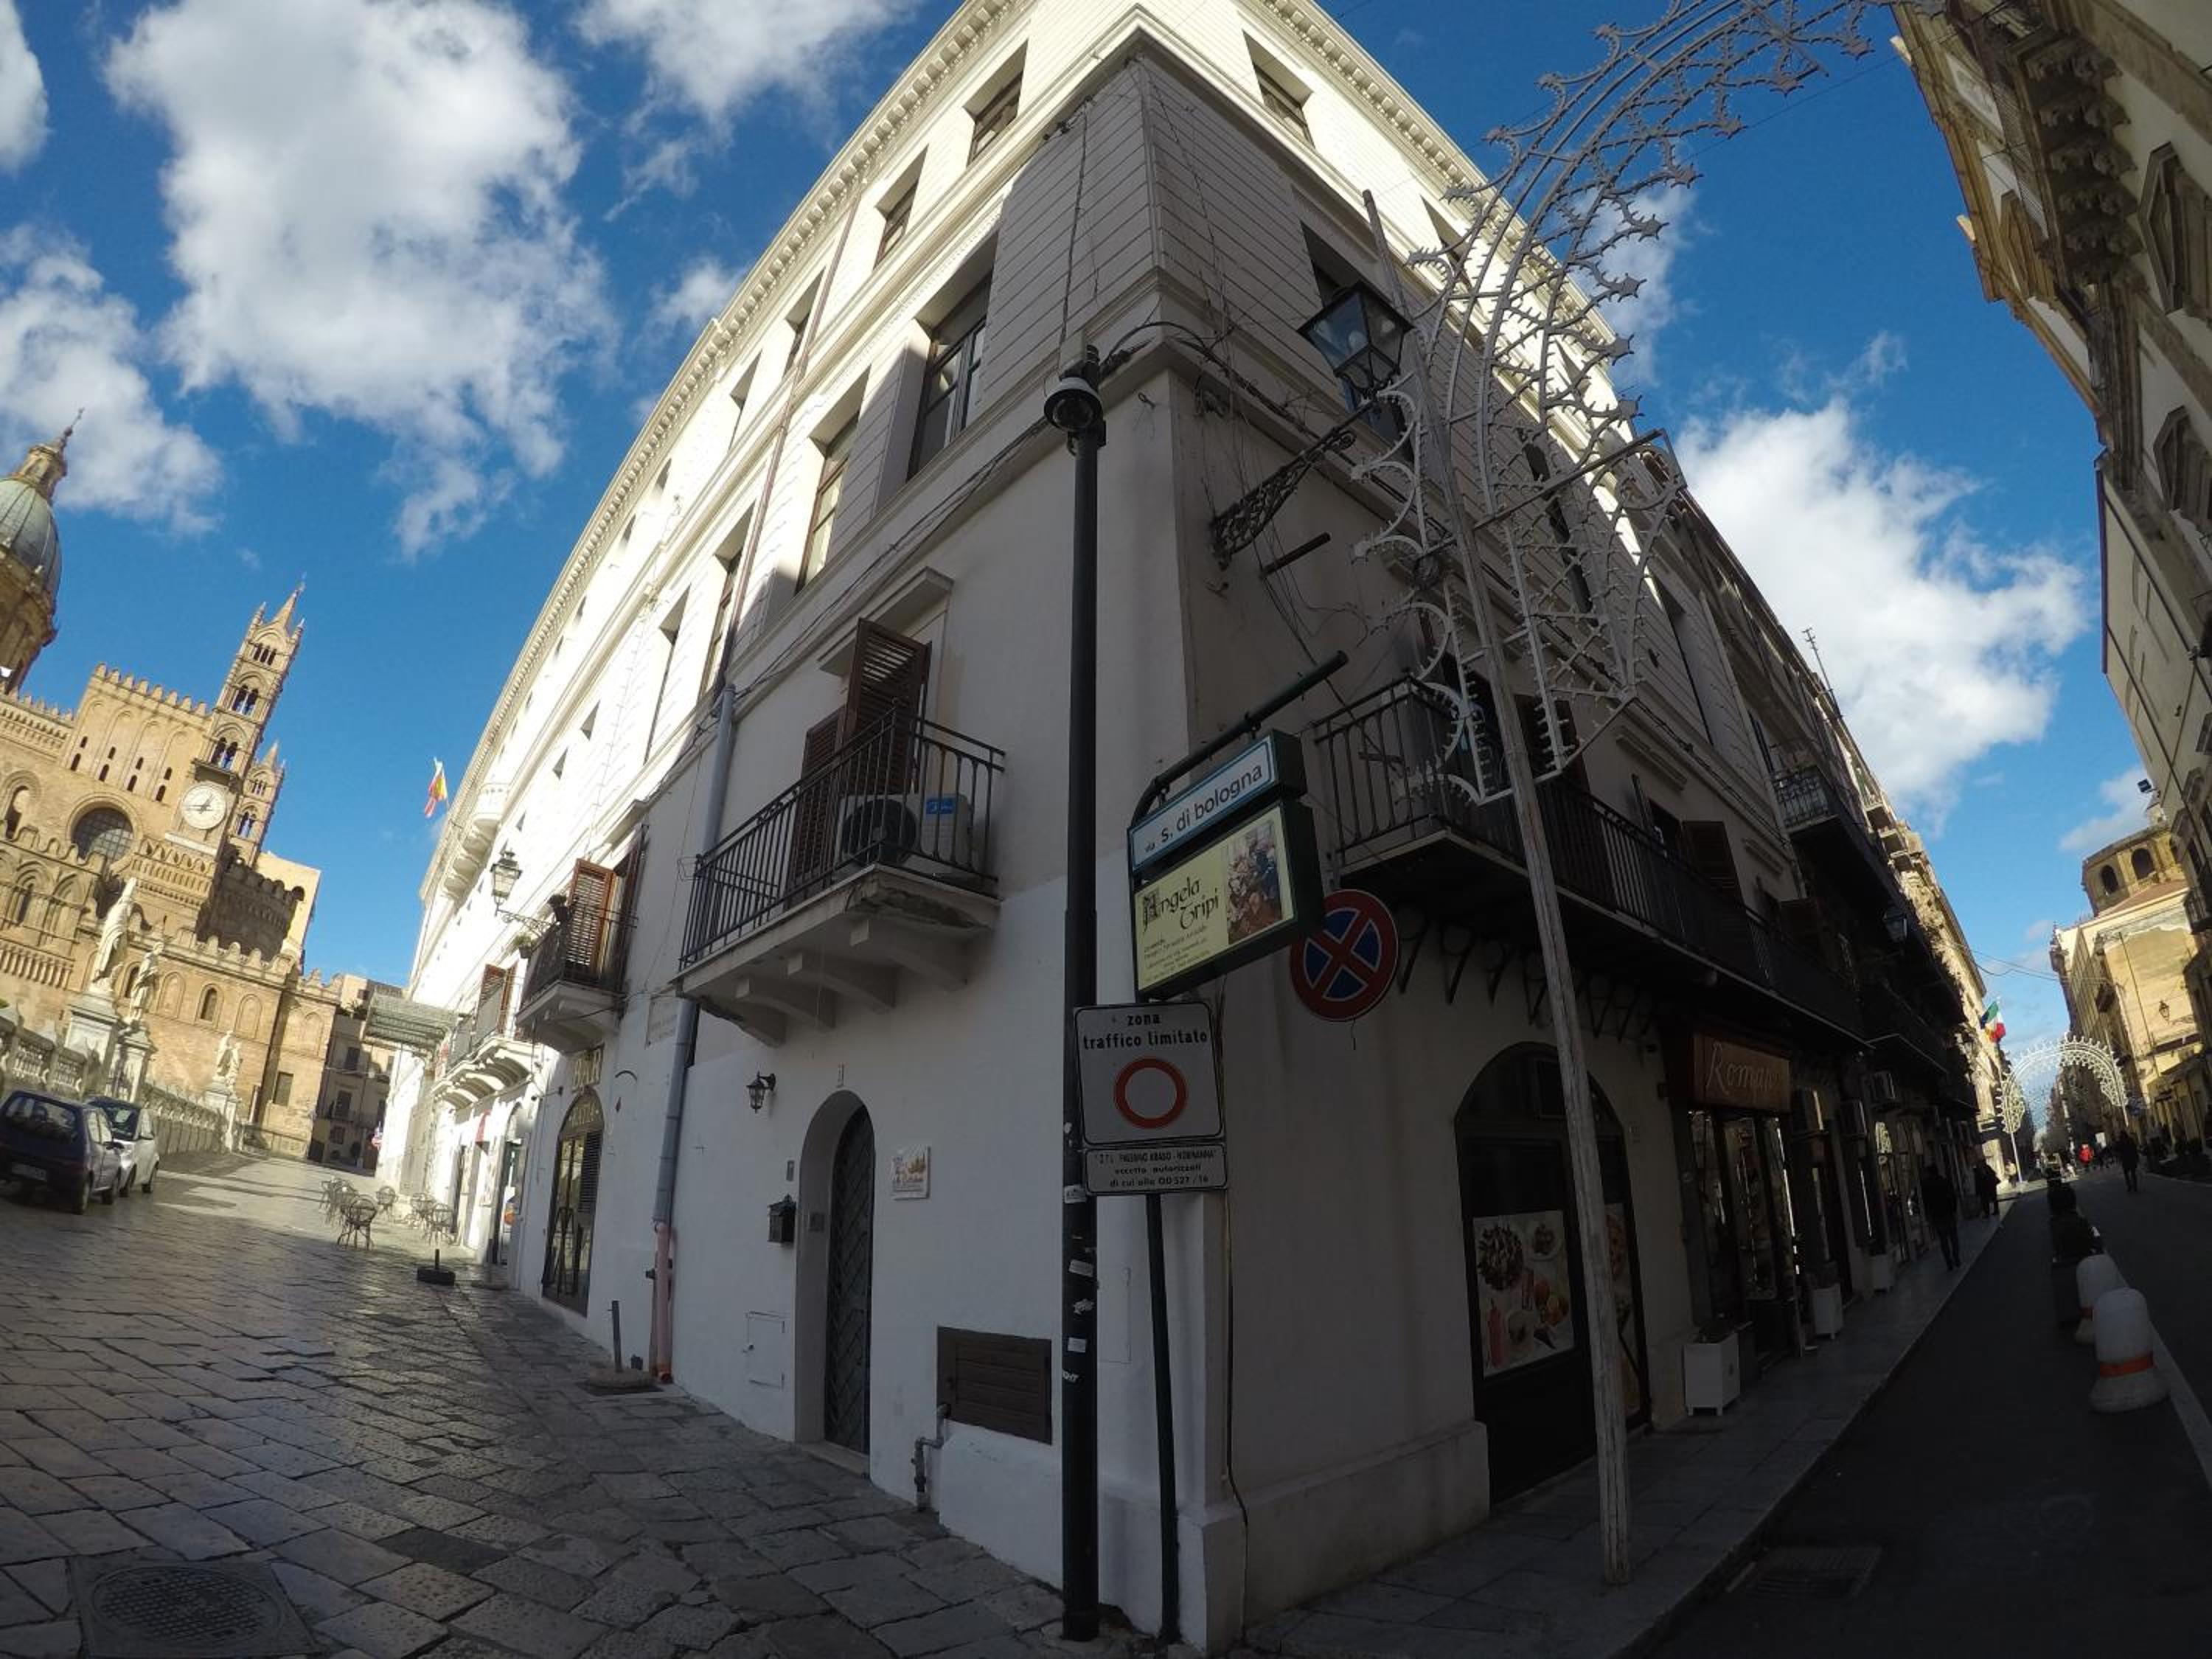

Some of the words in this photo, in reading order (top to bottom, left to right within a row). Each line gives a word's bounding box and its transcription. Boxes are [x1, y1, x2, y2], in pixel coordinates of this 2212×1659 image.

[1176, 809, 1191, 831] di
[1193, 765, 1263, 821] bologna
[1143, 877, 1200, 932] Angela
[1127, 1014, 1161, 1026] zona
[1083, 1033, 1141, 1050] traffico
[1148, 1029, 1208, 1046] limitato
